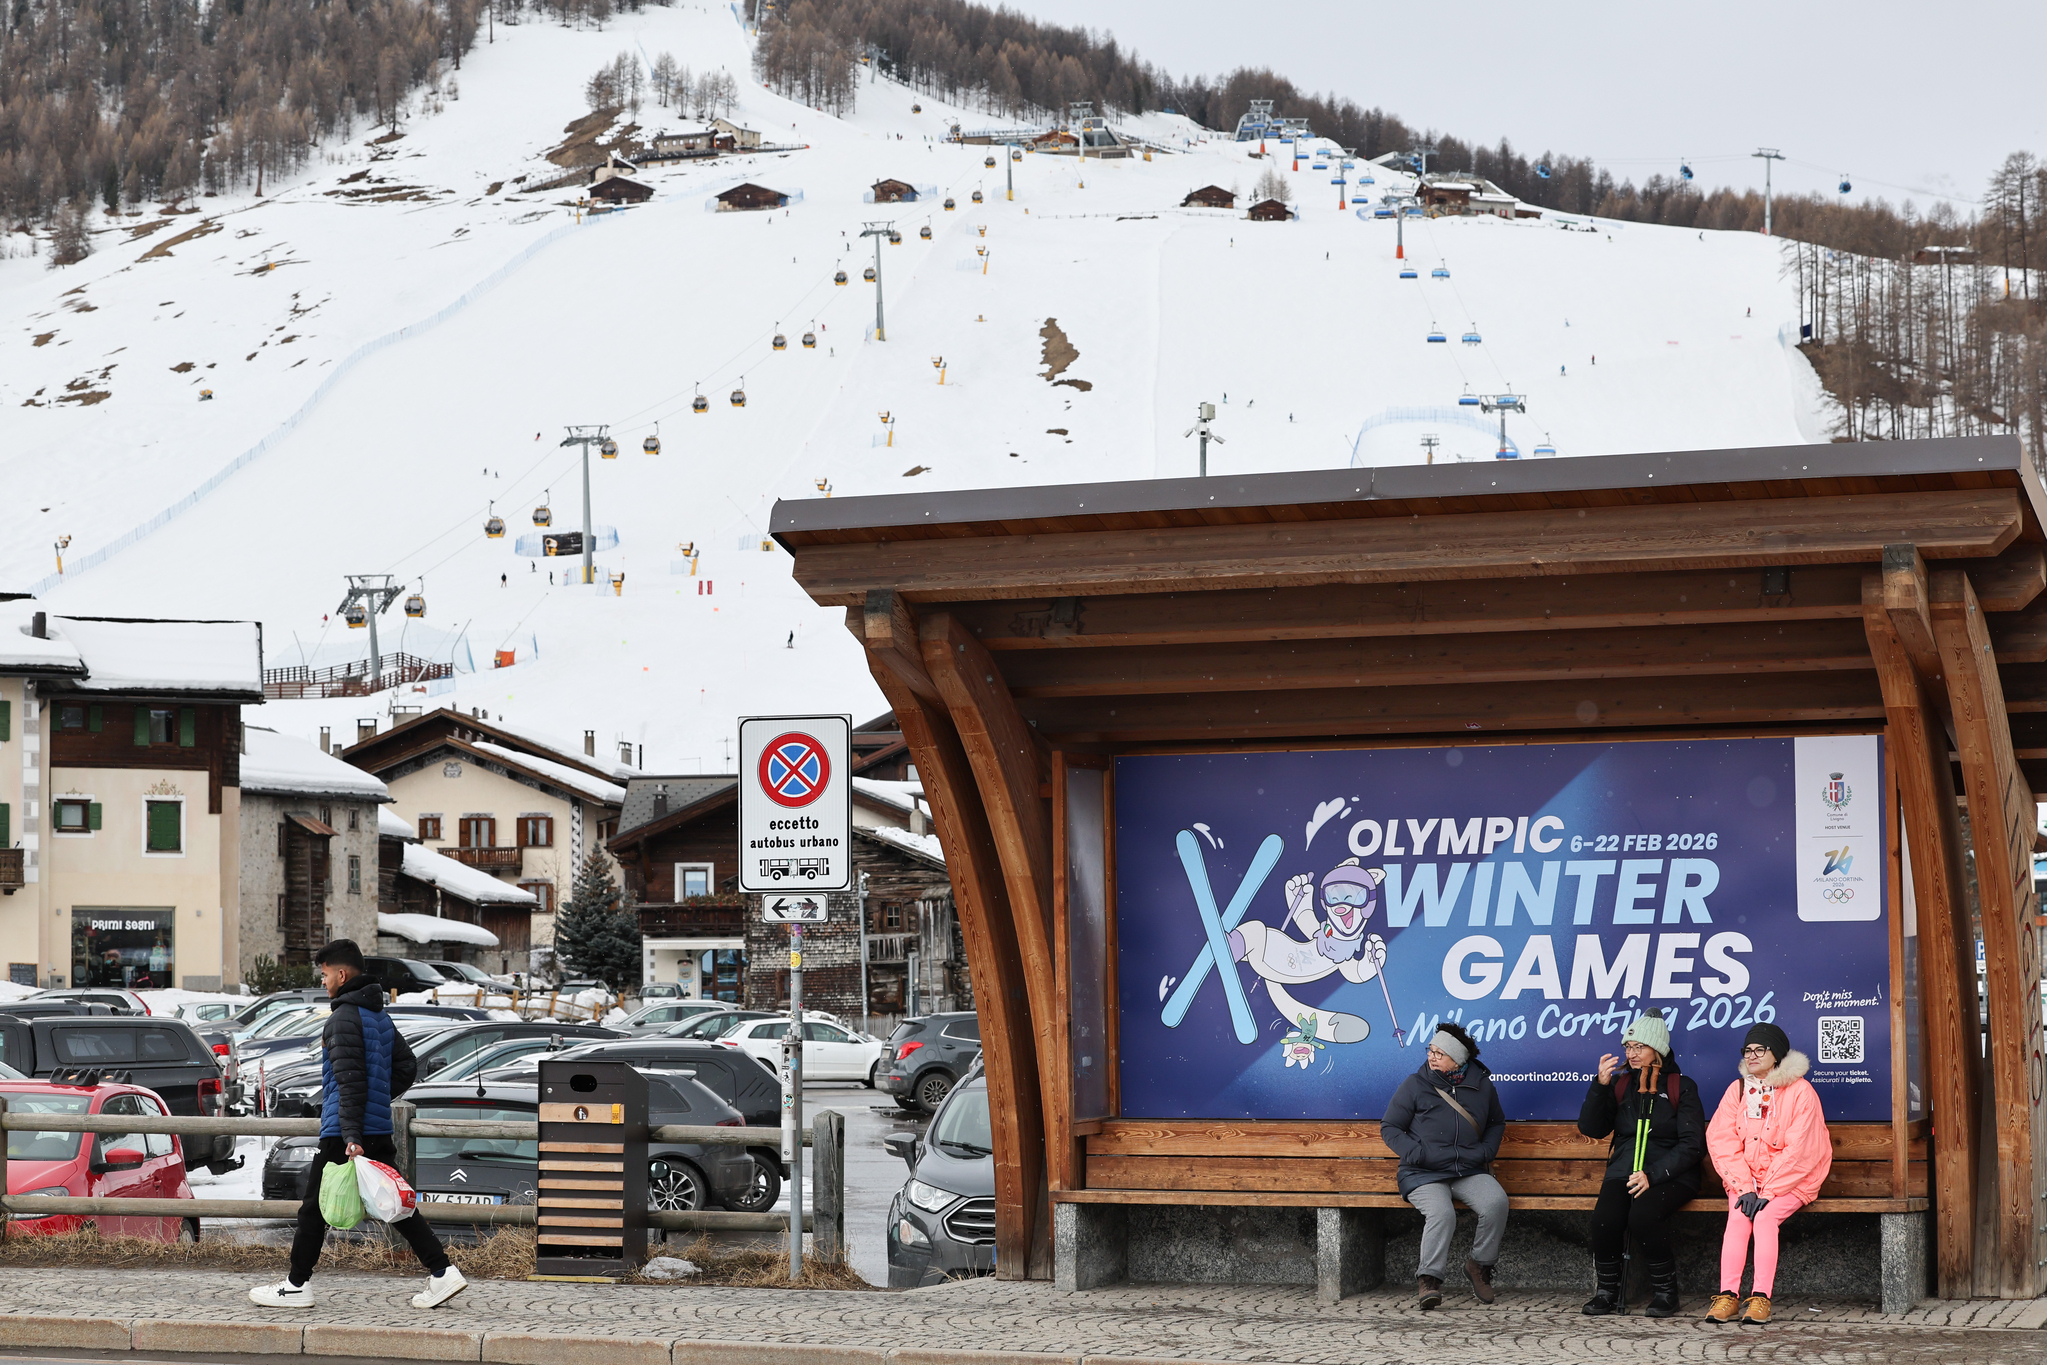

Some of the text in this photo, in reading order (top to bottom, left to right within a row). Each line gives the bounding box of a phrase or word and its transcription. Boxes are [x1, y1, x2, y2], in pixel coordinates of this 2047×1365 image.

[769, 816, 819, 830] eccetto
[1348, 815, 1564, 857] OLYMPIC
[1623, 834, 1662, 851] FEB
[1665, 832, 1719, 850] 2026
[750, 835, 839, 849] autobus urbano
[1383, 858, 1720, 928] WINTER
[1441, 931, 1753, 1001] GAMES
[1803, 989, 1853, 1002] Don't miss
[1815, 996, 1880, 1009] the moment.
[1686, 991, 1776, 1030] 2026
